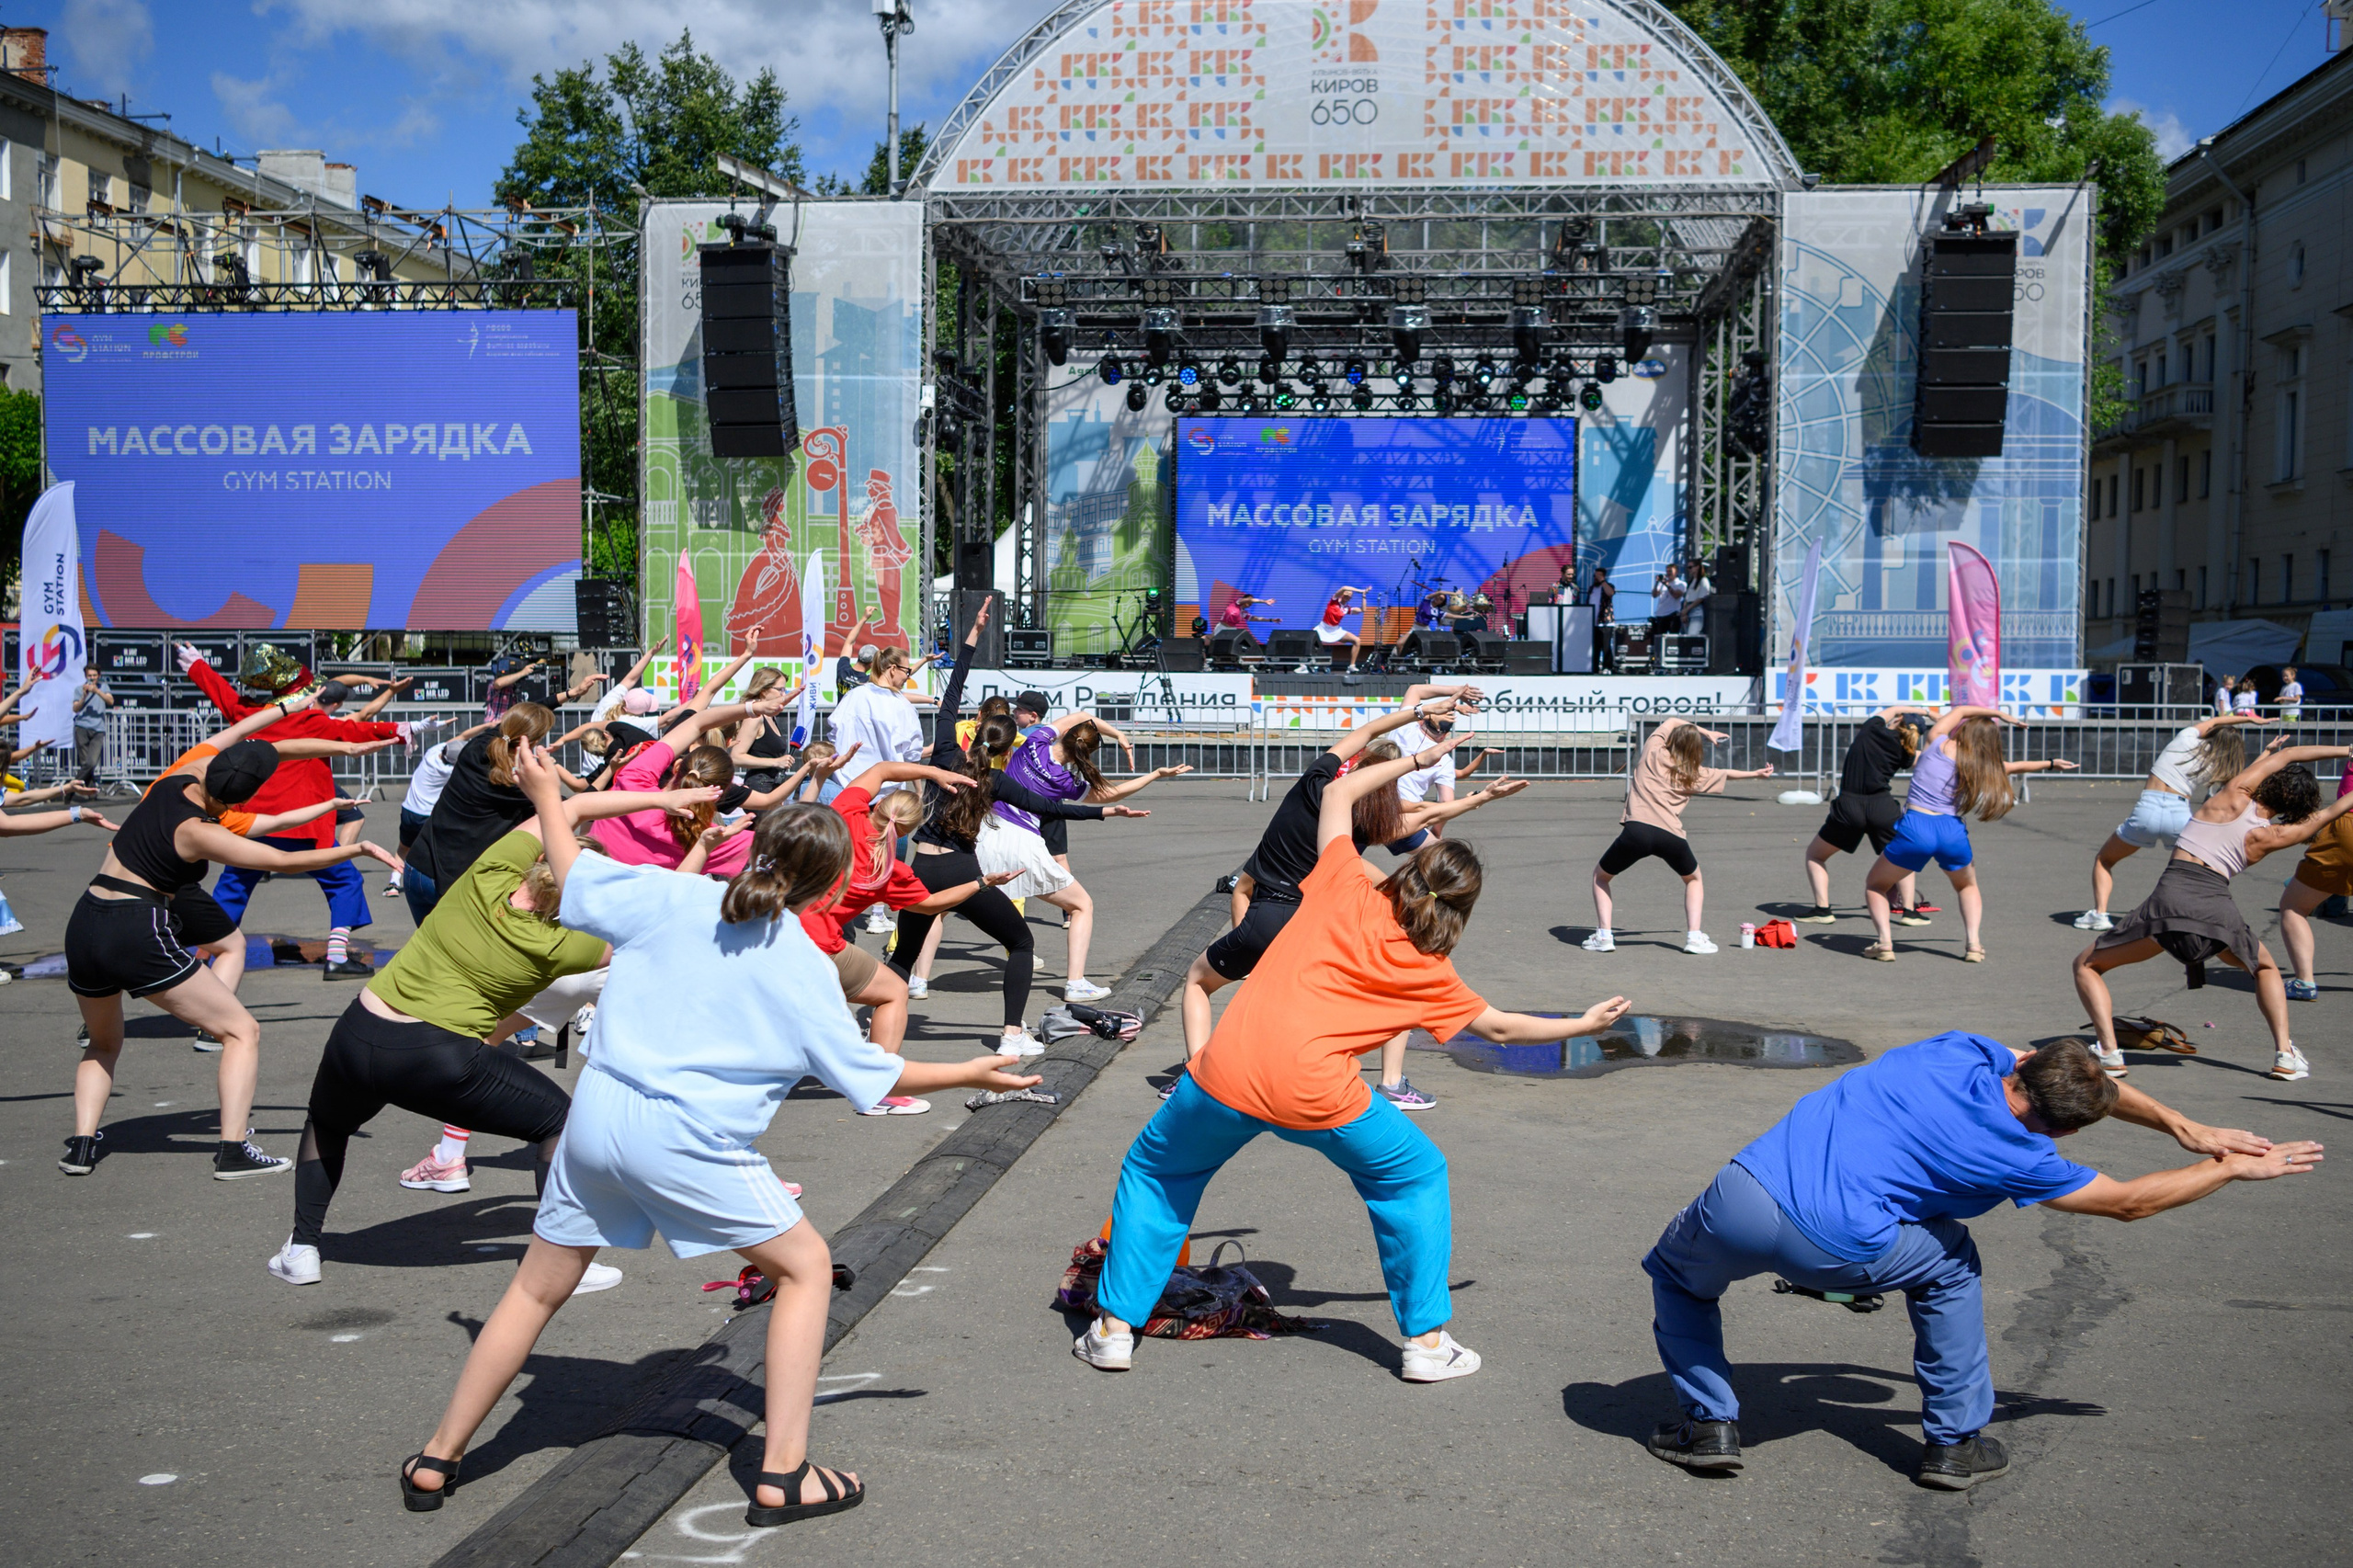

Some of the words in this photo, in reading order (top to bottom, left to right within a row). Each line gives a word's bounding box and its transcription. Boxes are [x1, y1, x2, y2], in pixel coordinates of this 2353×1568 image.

[1311, 78, 1379, 93] КИРОВ
[1311, 98, 1379, 125] 650
[88, 425, 315, 455] МАССОВАЯ
[328, 423, 533, 460] ЗАРЯДКА
[222, 471, 278, 491] GYM
[285, 471, 392, 491] STATION
[1207, 504, 1380, 528] МАССОВАЯ
[1388, 505, 1539, 532] ЗАРЯДКА
[1308, 540, 1349, 553] GYM
[1355, 540, 1436, 553] STATION
[56, 553, 64, 615] STATION
[44, 582, 53, 614] GYM
[978, 685, 1063, 706] Днм
[1075, 686, 1235, 712] Рдения
[1460, 689, 1606, 713] юбимый
[1619, 692, 1722, 715] город!
